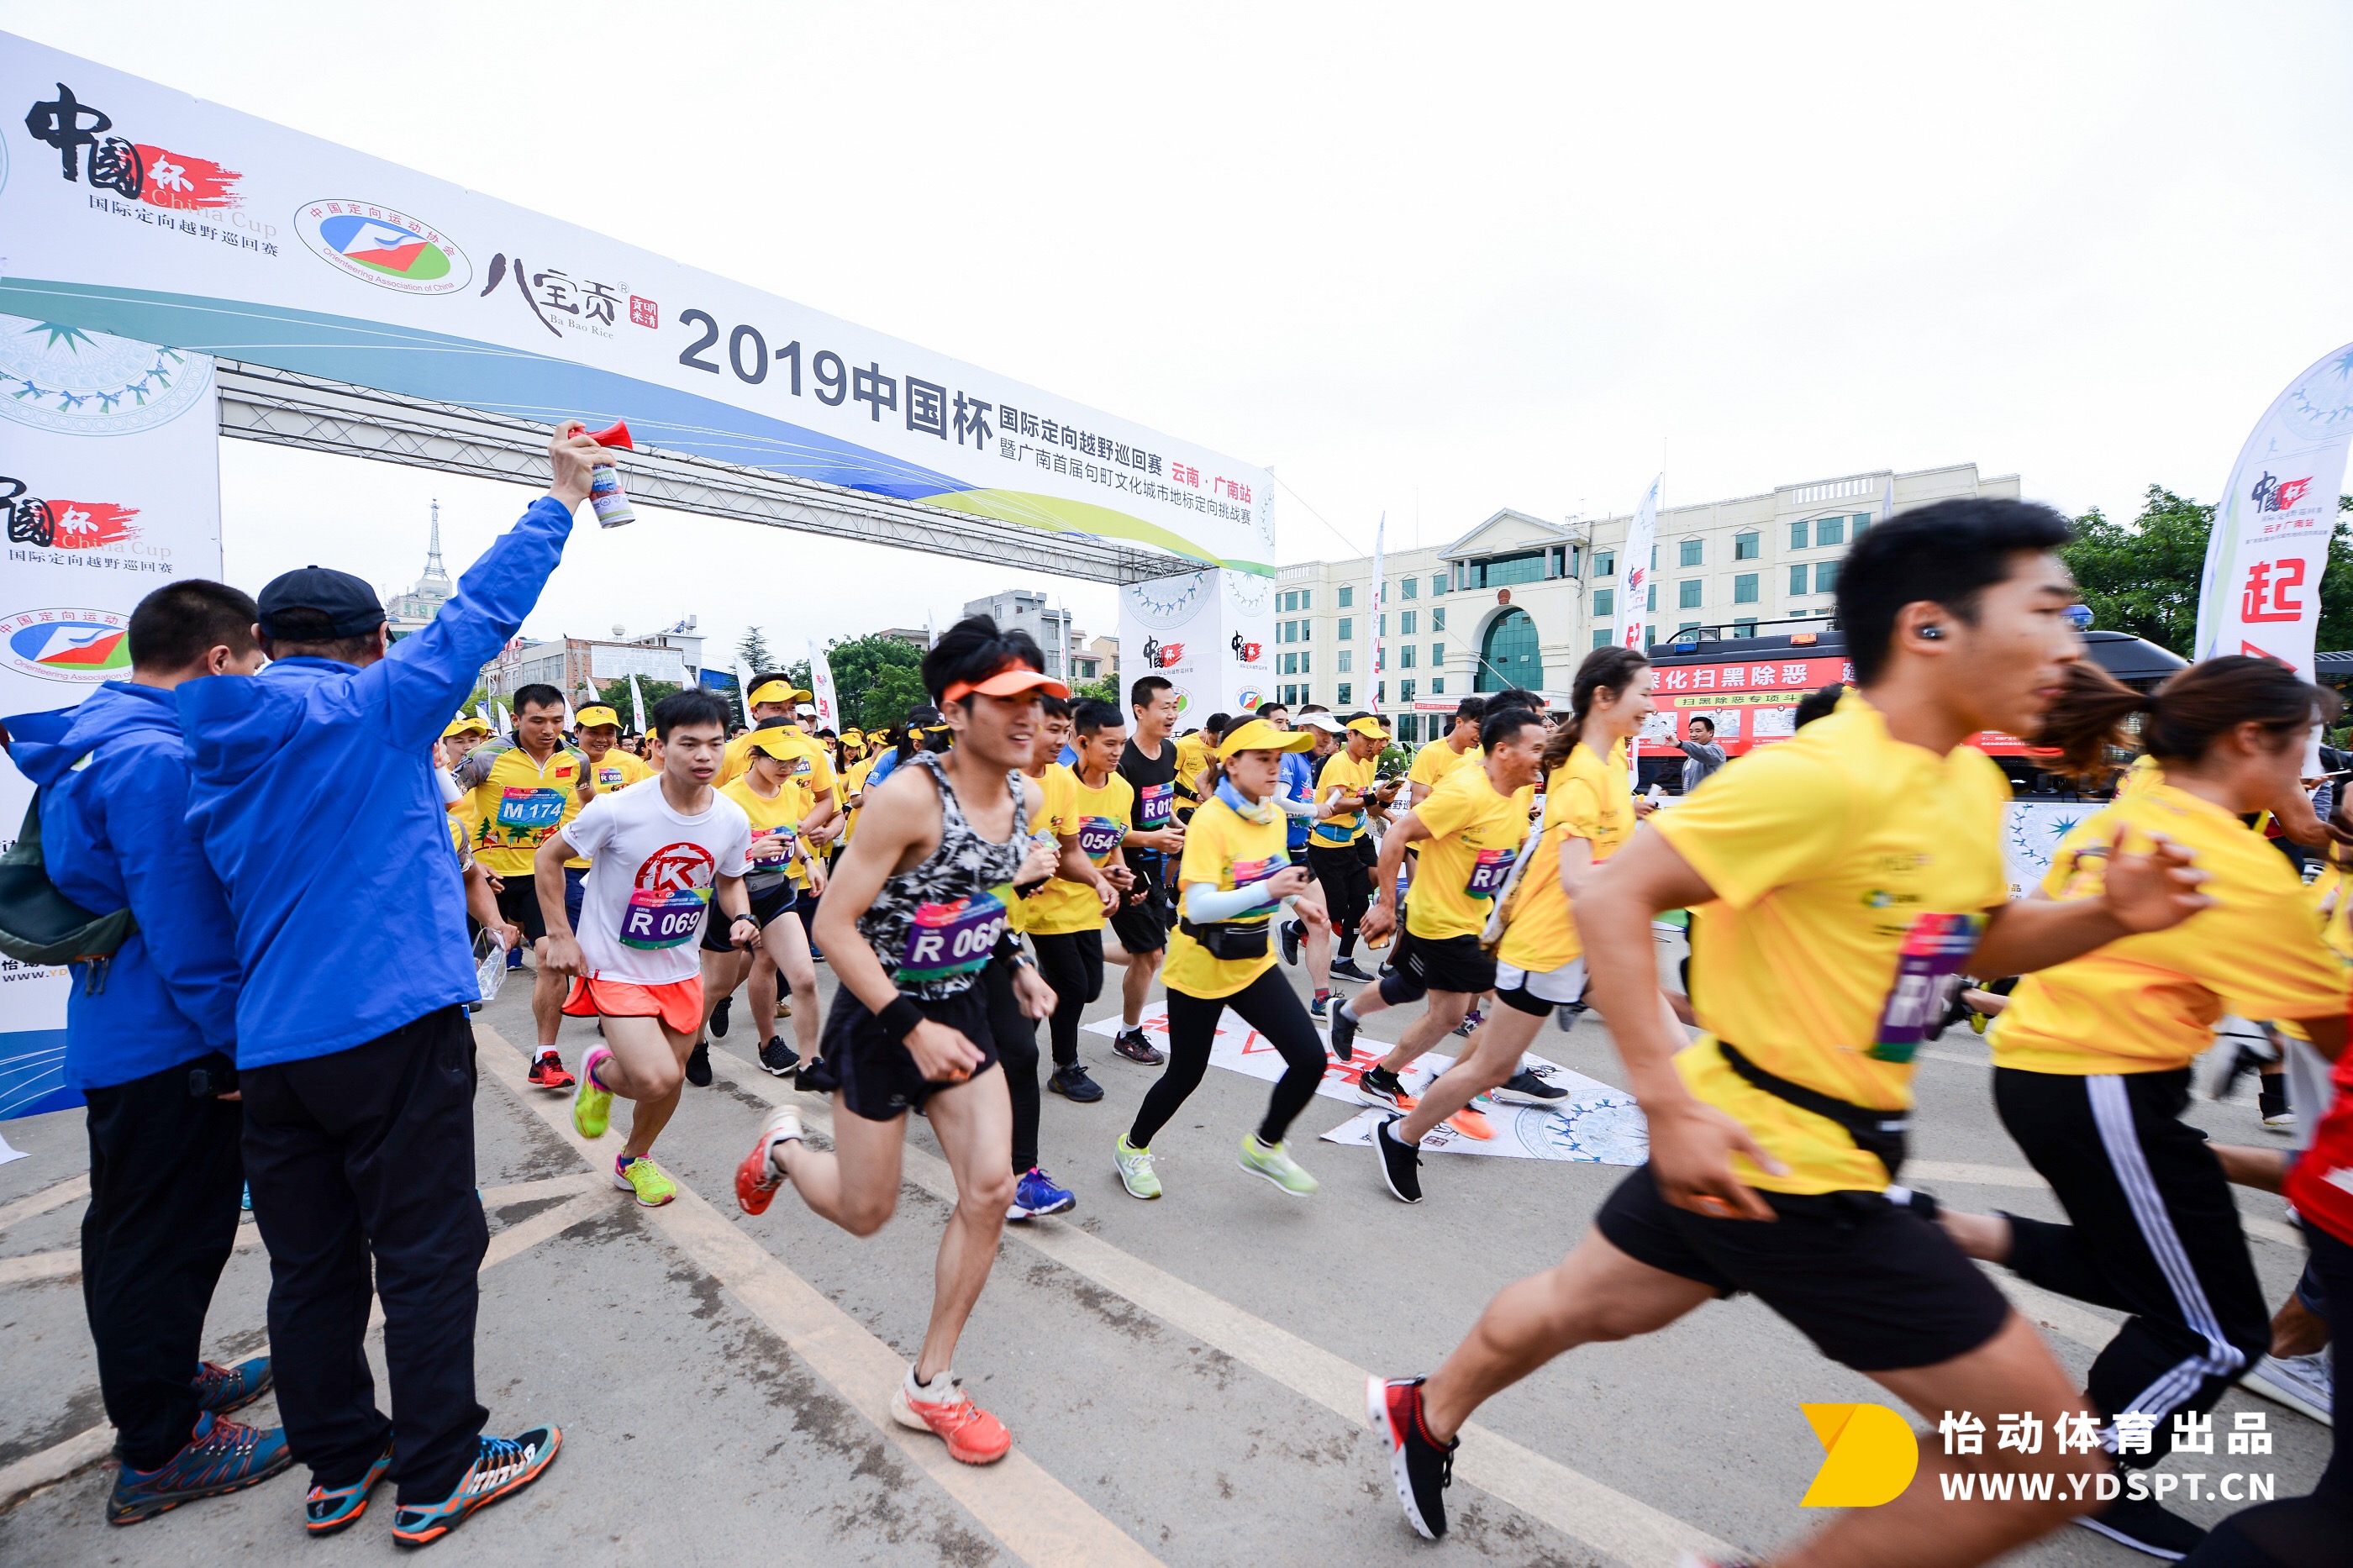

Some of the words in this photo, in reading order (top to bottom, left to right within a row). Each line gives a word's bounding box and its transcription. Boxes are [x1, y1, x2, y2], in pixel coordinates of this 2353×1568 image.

[89, 194, 278, 257] 国际定向越野巡回赛
[151, 189, 224, 223] China
[231, 212, 277, 239] Cup
[310, 203, 455, 257] 中国定向运动协会
[323, 247, 374, 282] Orienteering
[376, 276, 423, 292] Association
[433, 282, 455, 292] China
[550, 314, 564, 326] Ba
[568, 318, 588, 332] Bao
[592, 325, 614, 339] Rice
[678, 308, 993, 450] 2019中国杯
[999, 403, 1162, 476] 国际定向越野巡回赛
[999, 437, 1252, 526] 暨广南首届句町文化城市地标定向挑战赛
[62, 534, 124, 554] China
[132, 541, 171, 560] Cup
[9, 549, 173, 574] 国际定向越野巡回赛
[2241, 558, 2305, 624] 起
[0, 611, 129, 634] 中国定向运动
[13, 659, 68, 680] Orienteering
[71, 672, 120, 681] Association
[122, 671, 132, 679] of
[503, 802, 524, 818] M
[529, 802, 562, 818] 174
[1145, 802, 1155, 818] R
[1082, 833, 1114, 850] 054
[1472, 868, 1492, 887] R
[629, 912, 654, 936] R
[661, 911, 701, 935] 069
[912, 935, 945, 962] R
